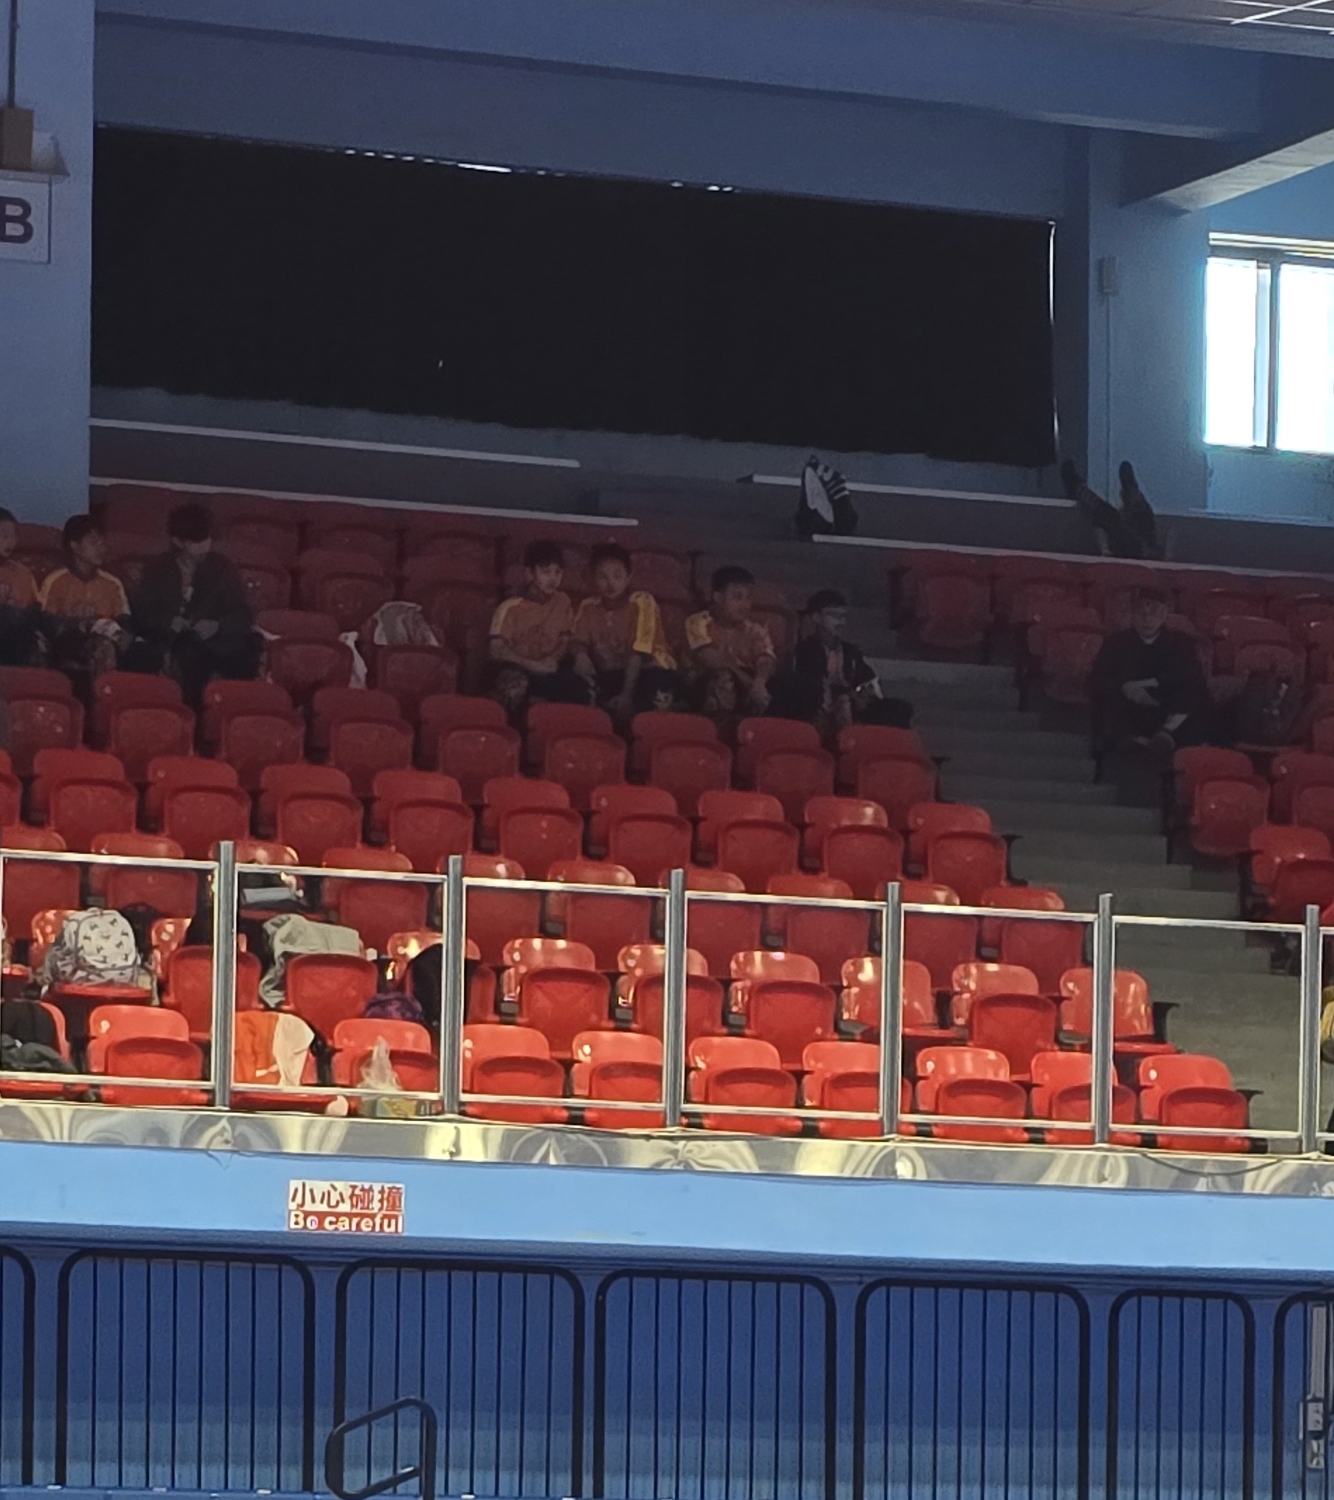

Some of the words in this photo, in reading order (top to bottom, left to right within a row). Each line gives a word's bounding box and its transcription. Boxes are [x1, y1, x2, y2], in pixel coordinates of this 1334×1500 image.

[290, 1181, 404, 1212] 小心碰撞
[289, 1211, 319, 1230] Be
[324, 1213, 403, 1233] careful
